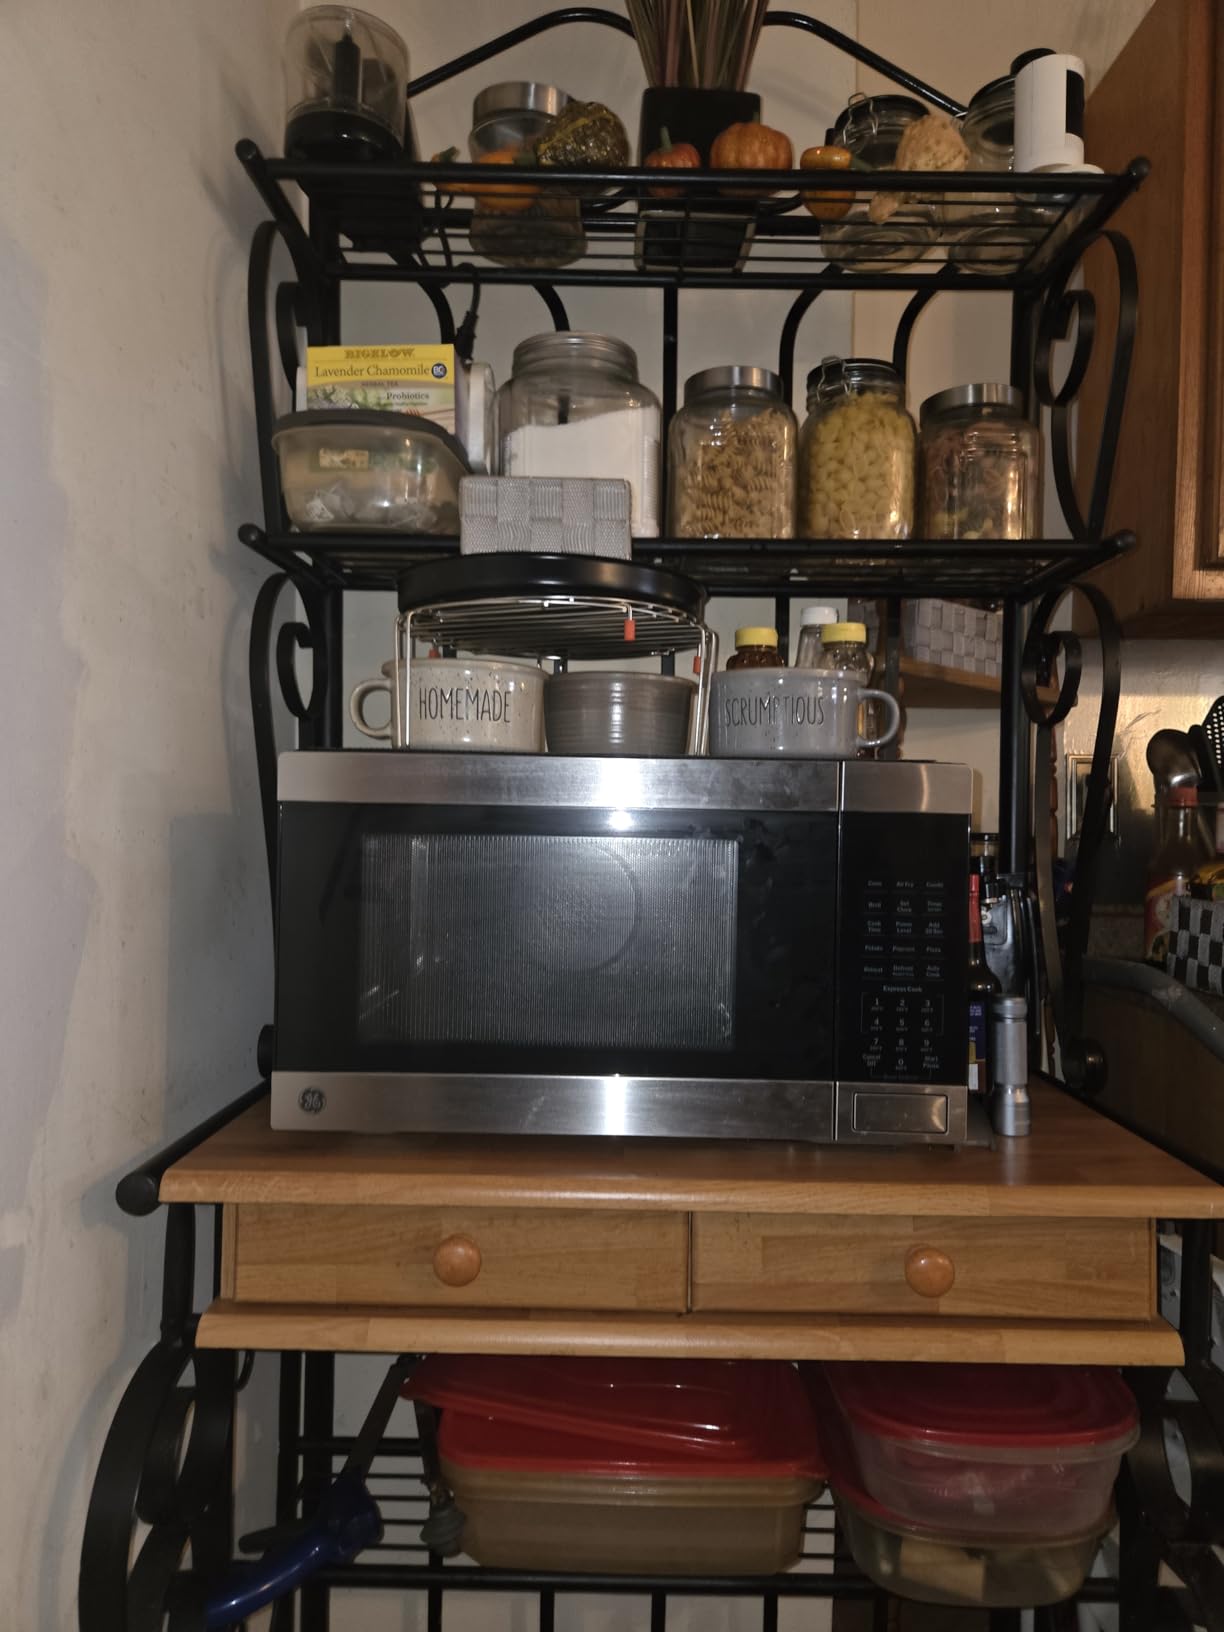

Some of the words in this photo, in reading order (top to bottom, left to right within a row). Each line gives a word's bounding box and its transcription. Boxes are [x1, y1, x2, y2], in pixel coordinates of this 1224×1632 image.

[344, 348, 415, 360] BIGELOW
[315, 366, 364, 378] Lavender
[366, 363, 430, 377] Chamomile
[386, 391, 430, 401] Probiotics
[418, 687, 512, 723] HOMEMADE
